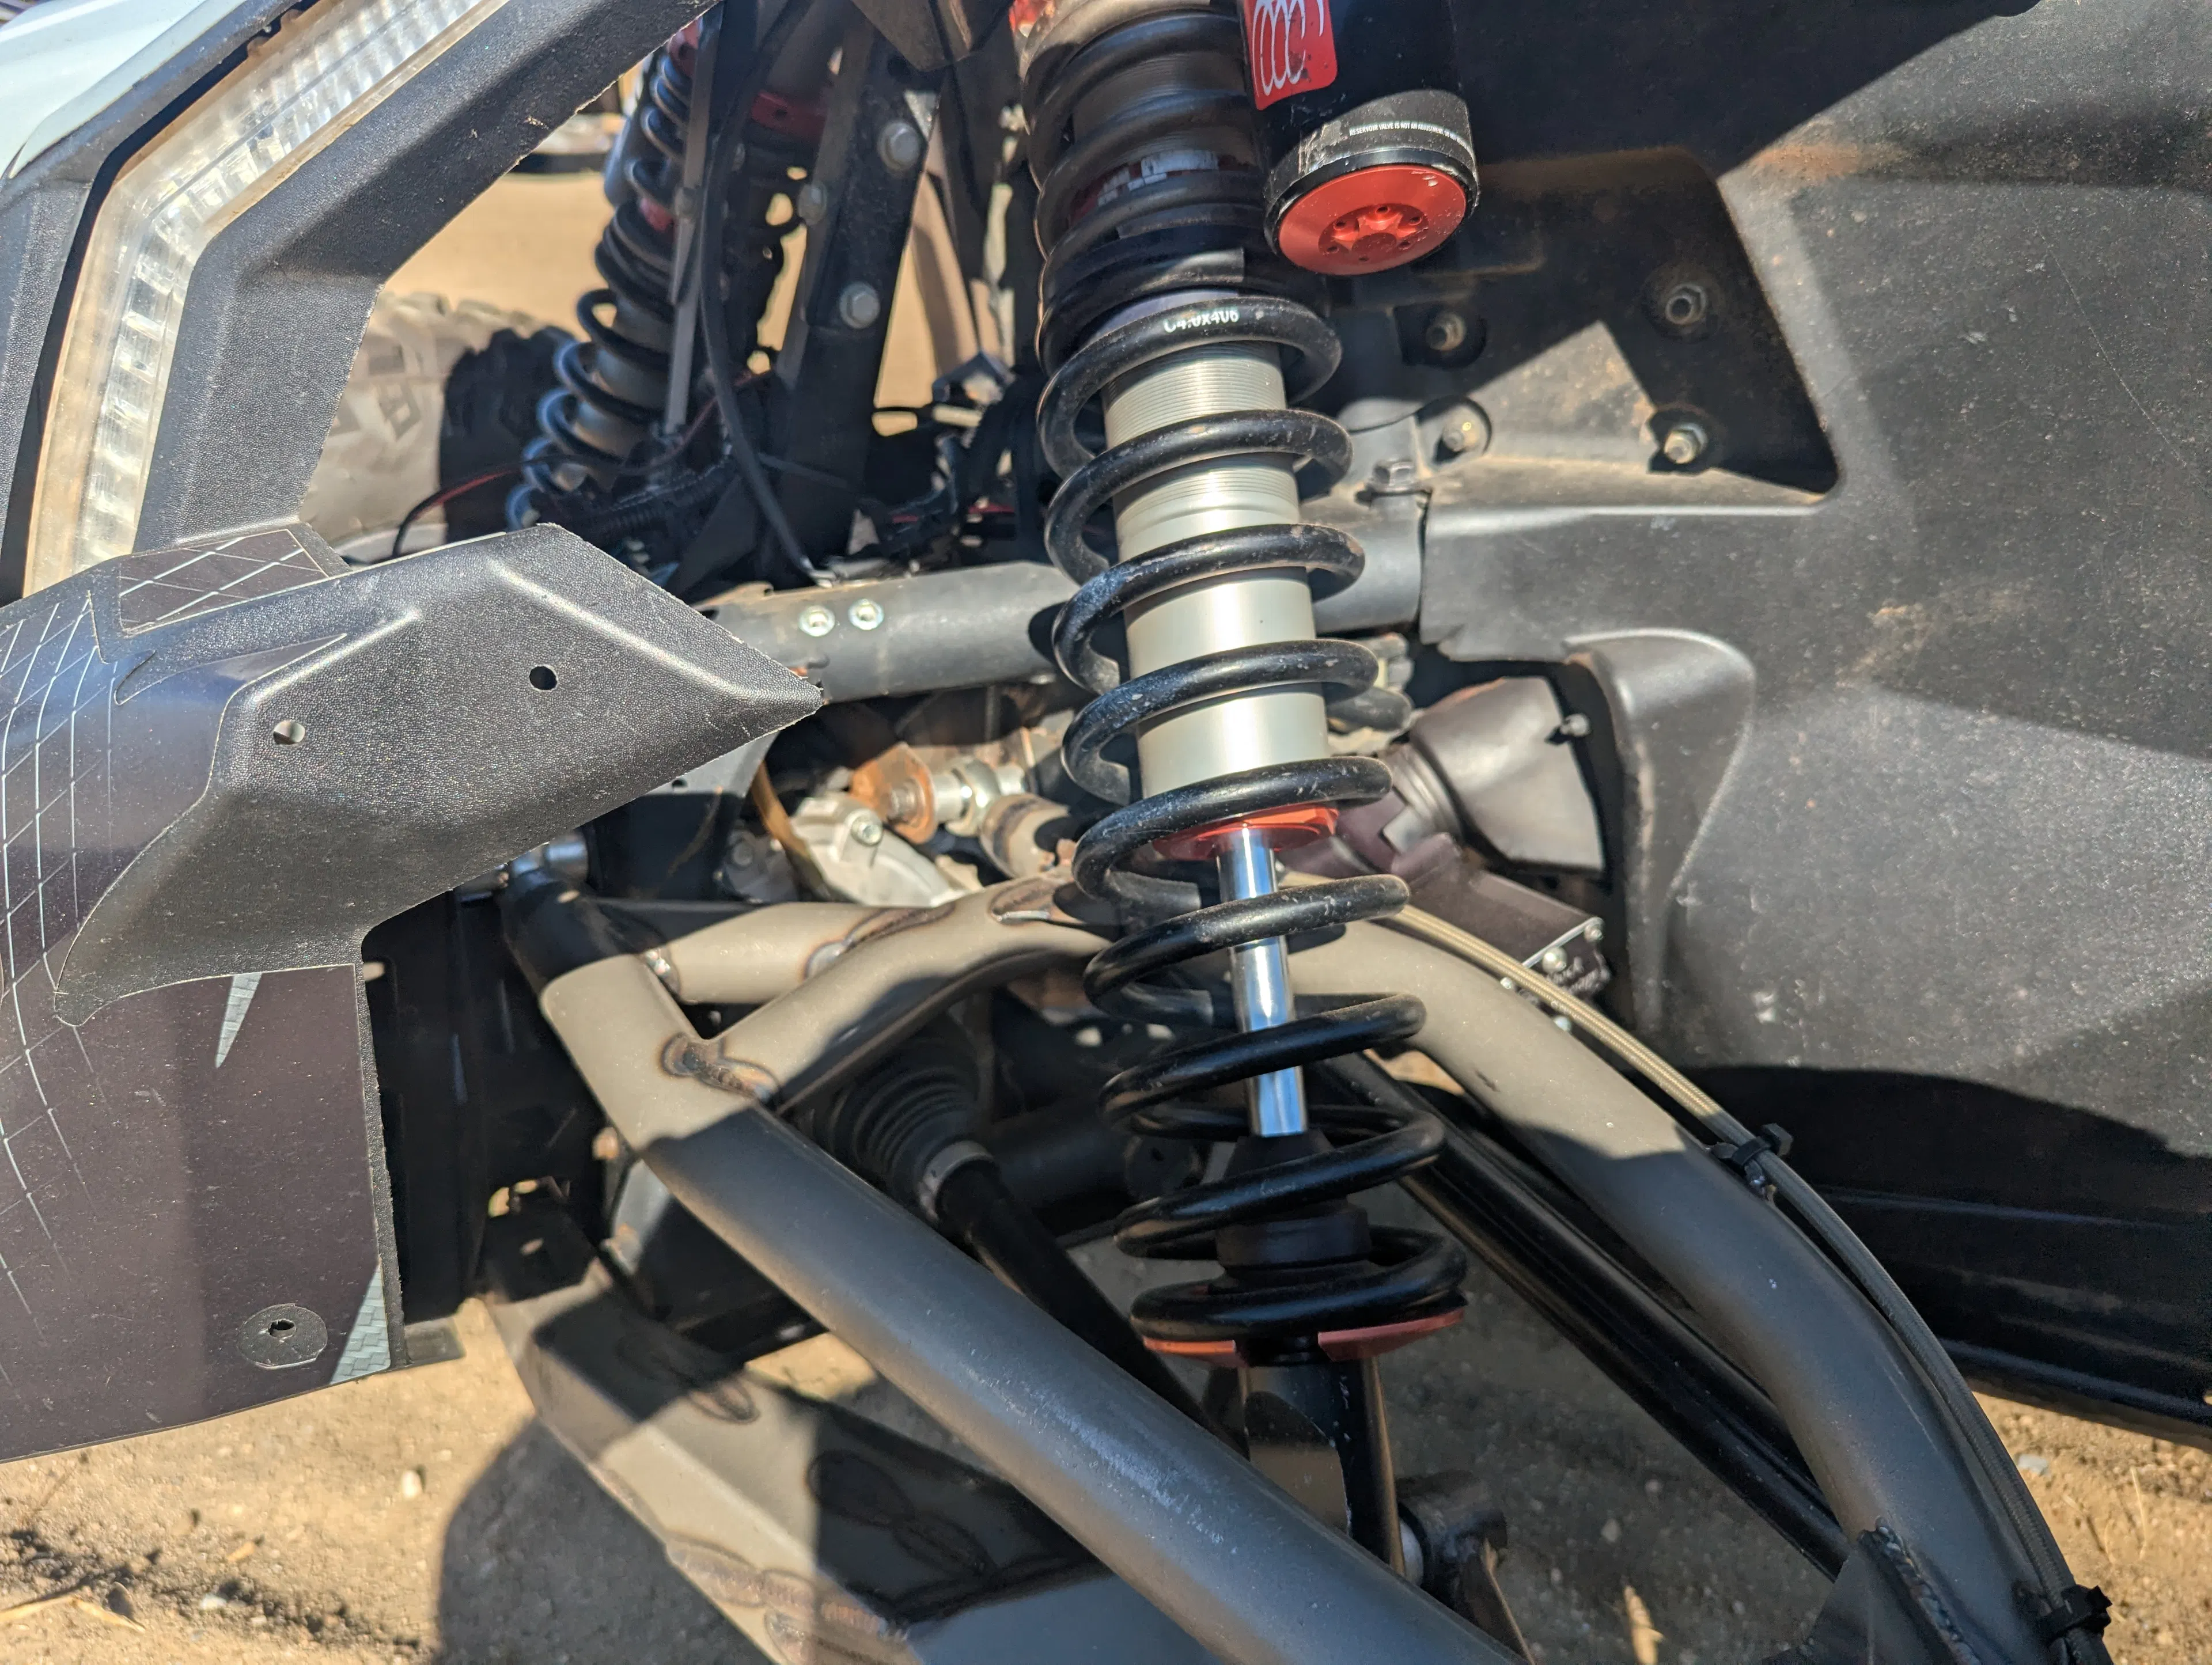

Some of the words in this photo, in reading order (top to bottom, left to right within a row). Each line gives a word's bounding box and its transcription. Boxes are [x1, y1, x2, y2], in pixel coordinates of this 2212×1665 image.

[1378, 122, 1394, 130] VALVE
[1394, 121, 1400, 129] IS
[1400, 120, 1410, 129] NOT
